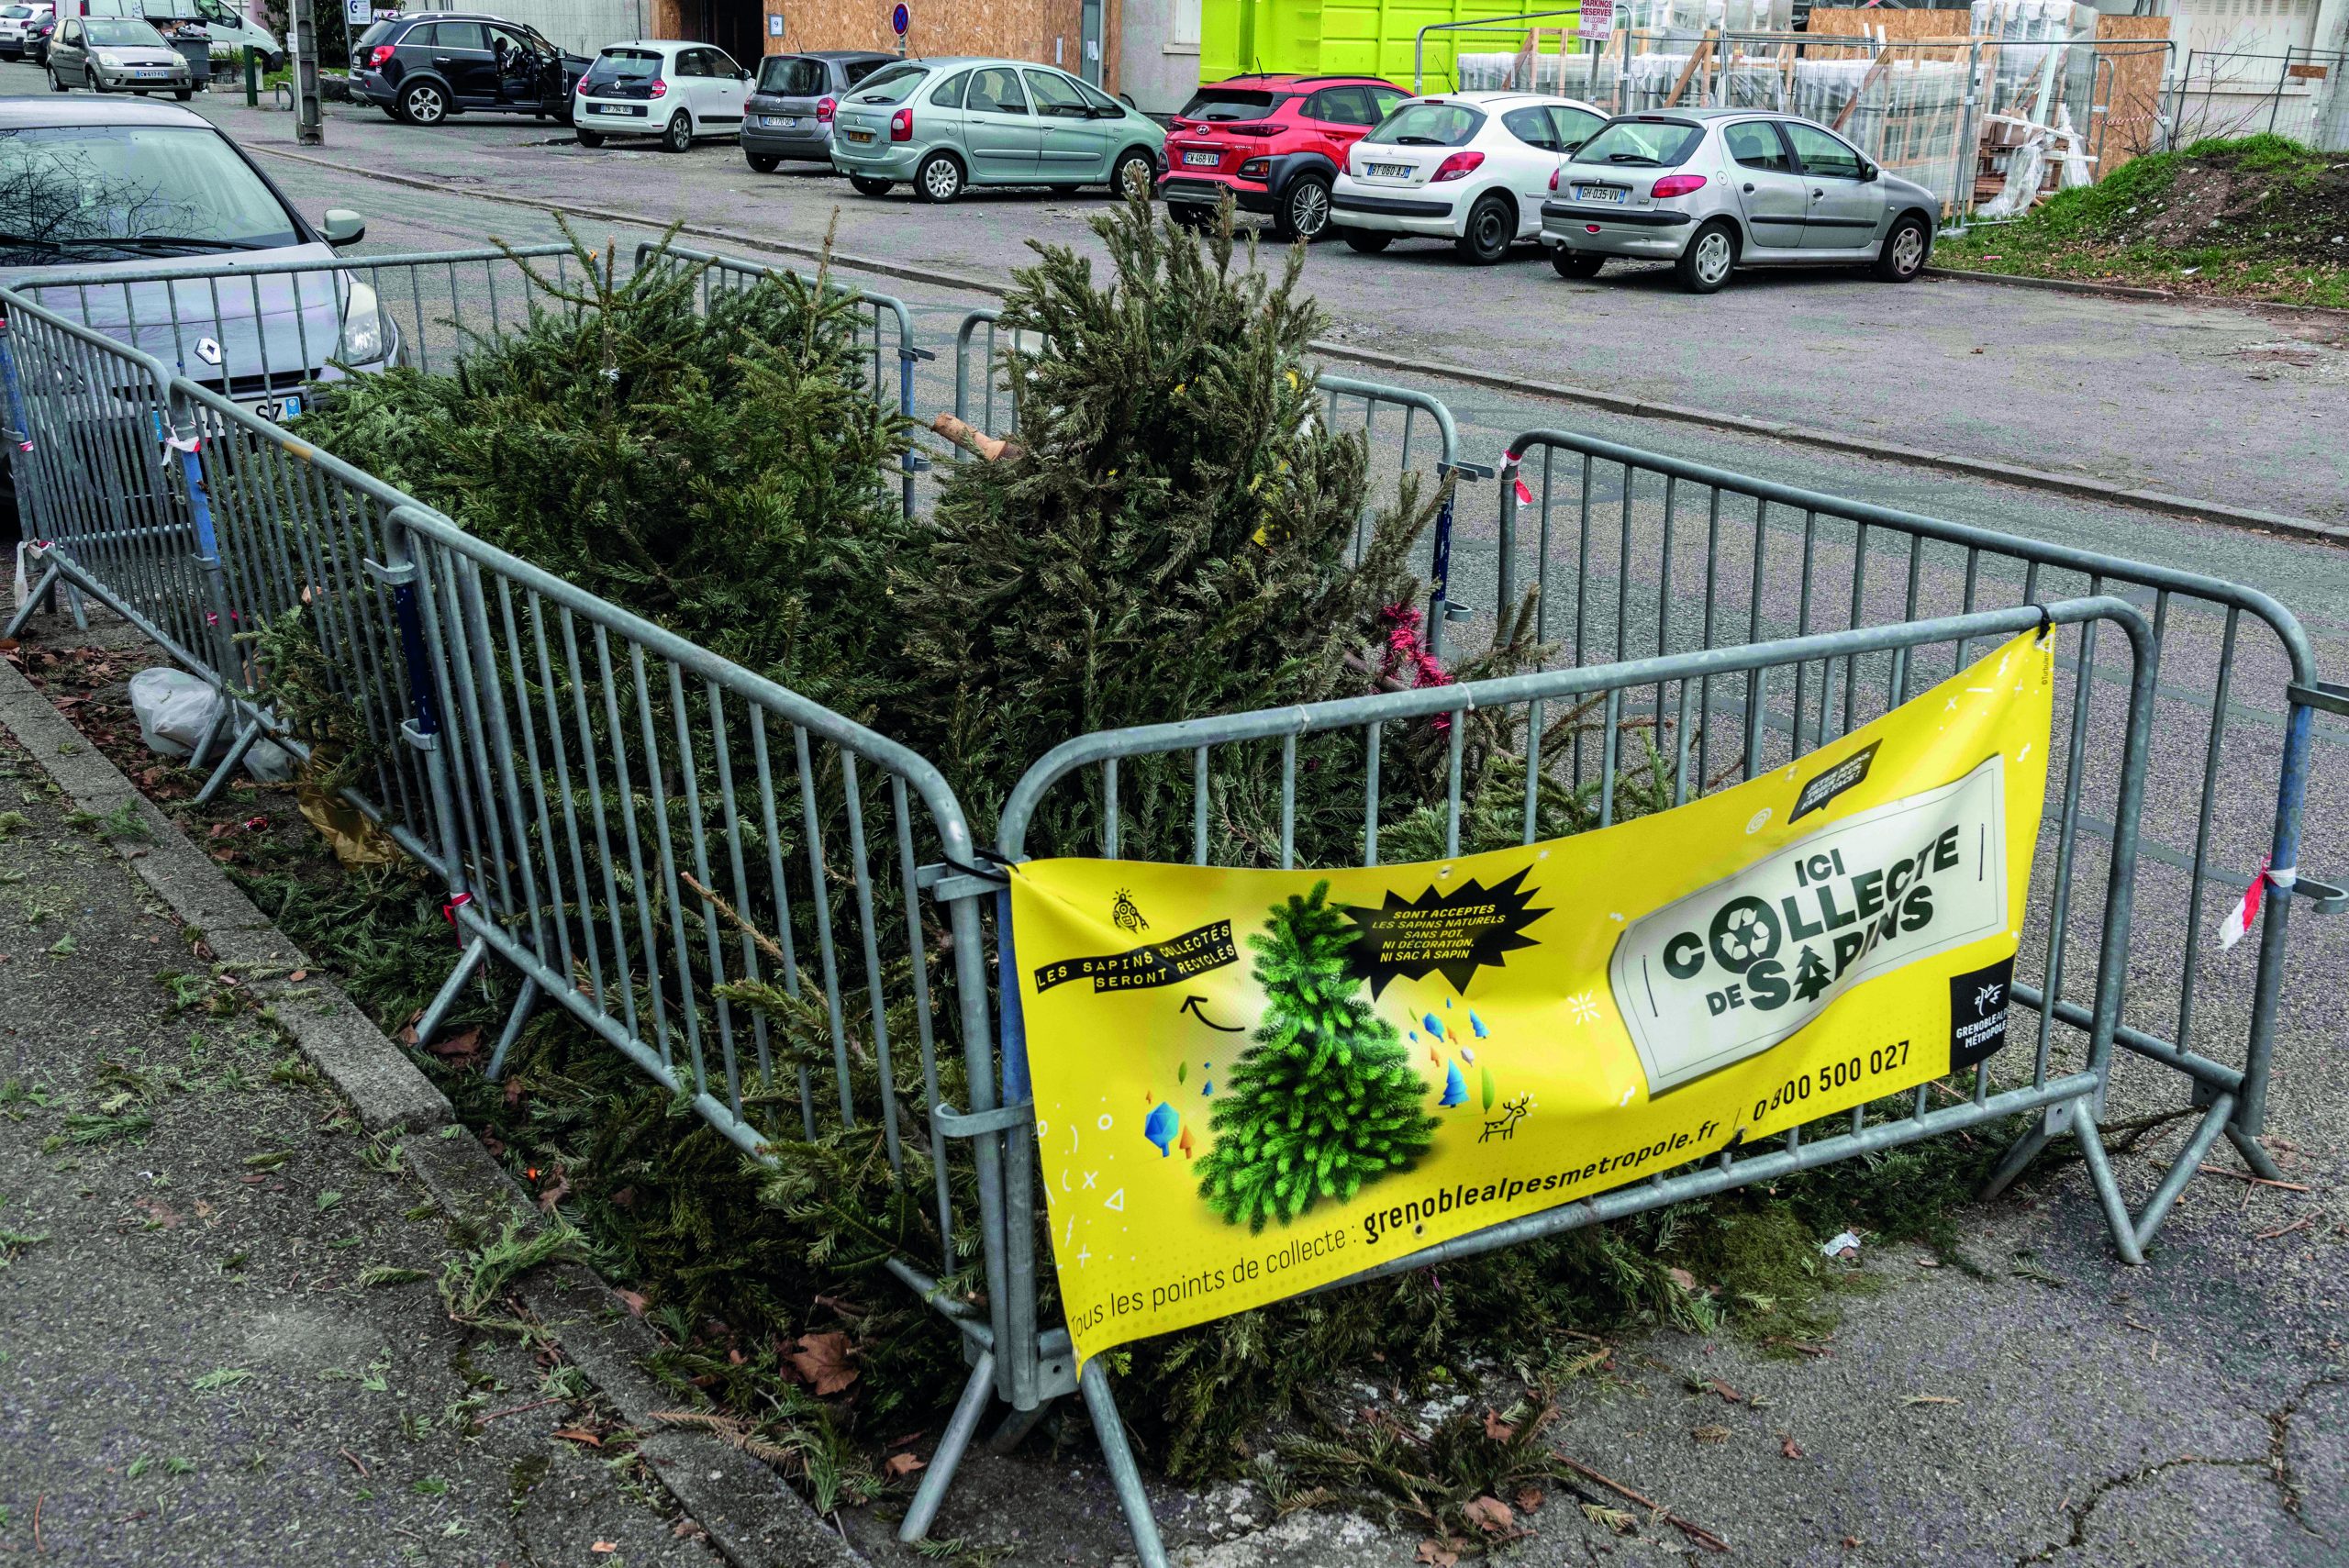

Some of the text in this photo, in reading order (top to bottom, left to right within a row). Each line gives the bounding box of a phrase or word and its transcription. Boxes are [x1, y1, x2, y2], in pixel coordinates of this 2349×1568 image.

[1582, 0, 1613, 8] PARKINGS
[1581, 8, 1612, 17] RESERVES
[1186, 151, 1215, 164] EW-468-VA
[1581, 188, 1620, 201] GH-035-VV
[1794, 848, 1846, 888] ICI
[1663, 825, 1959, 980] COLLECTE
[1393, 904, 1497, 919] SONT ACCEPTES
[1372, 915, 1507, 929] LES SAPINS NATURELS
[1403, 930, 1438, 939] SANS
[1382, 940, 1396, 950] NI
[1705, 884, 1933, 1017] DE SAPINS
[1036, 924, 1230, 987] LES SAPINS COLLECTÉS
[1379, 949, 1470, 962] NI SAC À SAPIN
[1096, 943, 1235, 988] SERONT RECYCLÉS
[1965, 1019, 2007, 1049] MÉTROPOLE
[1070, 1304, 1104, 1340] Tous
[1110, 1292, 1144, 1318] les
[1152, 1268, 1225, 1313] points
[1232, 1257, 1259, 1284] de
[1266, 1229, 1346, 1273] collecte
[1363, 1119, 1720, 1245] grenoblealpesmetropole.fr
[1819, 1057, 1862, 1093] 500
[1870, 1040, 1909, 1075] 027
